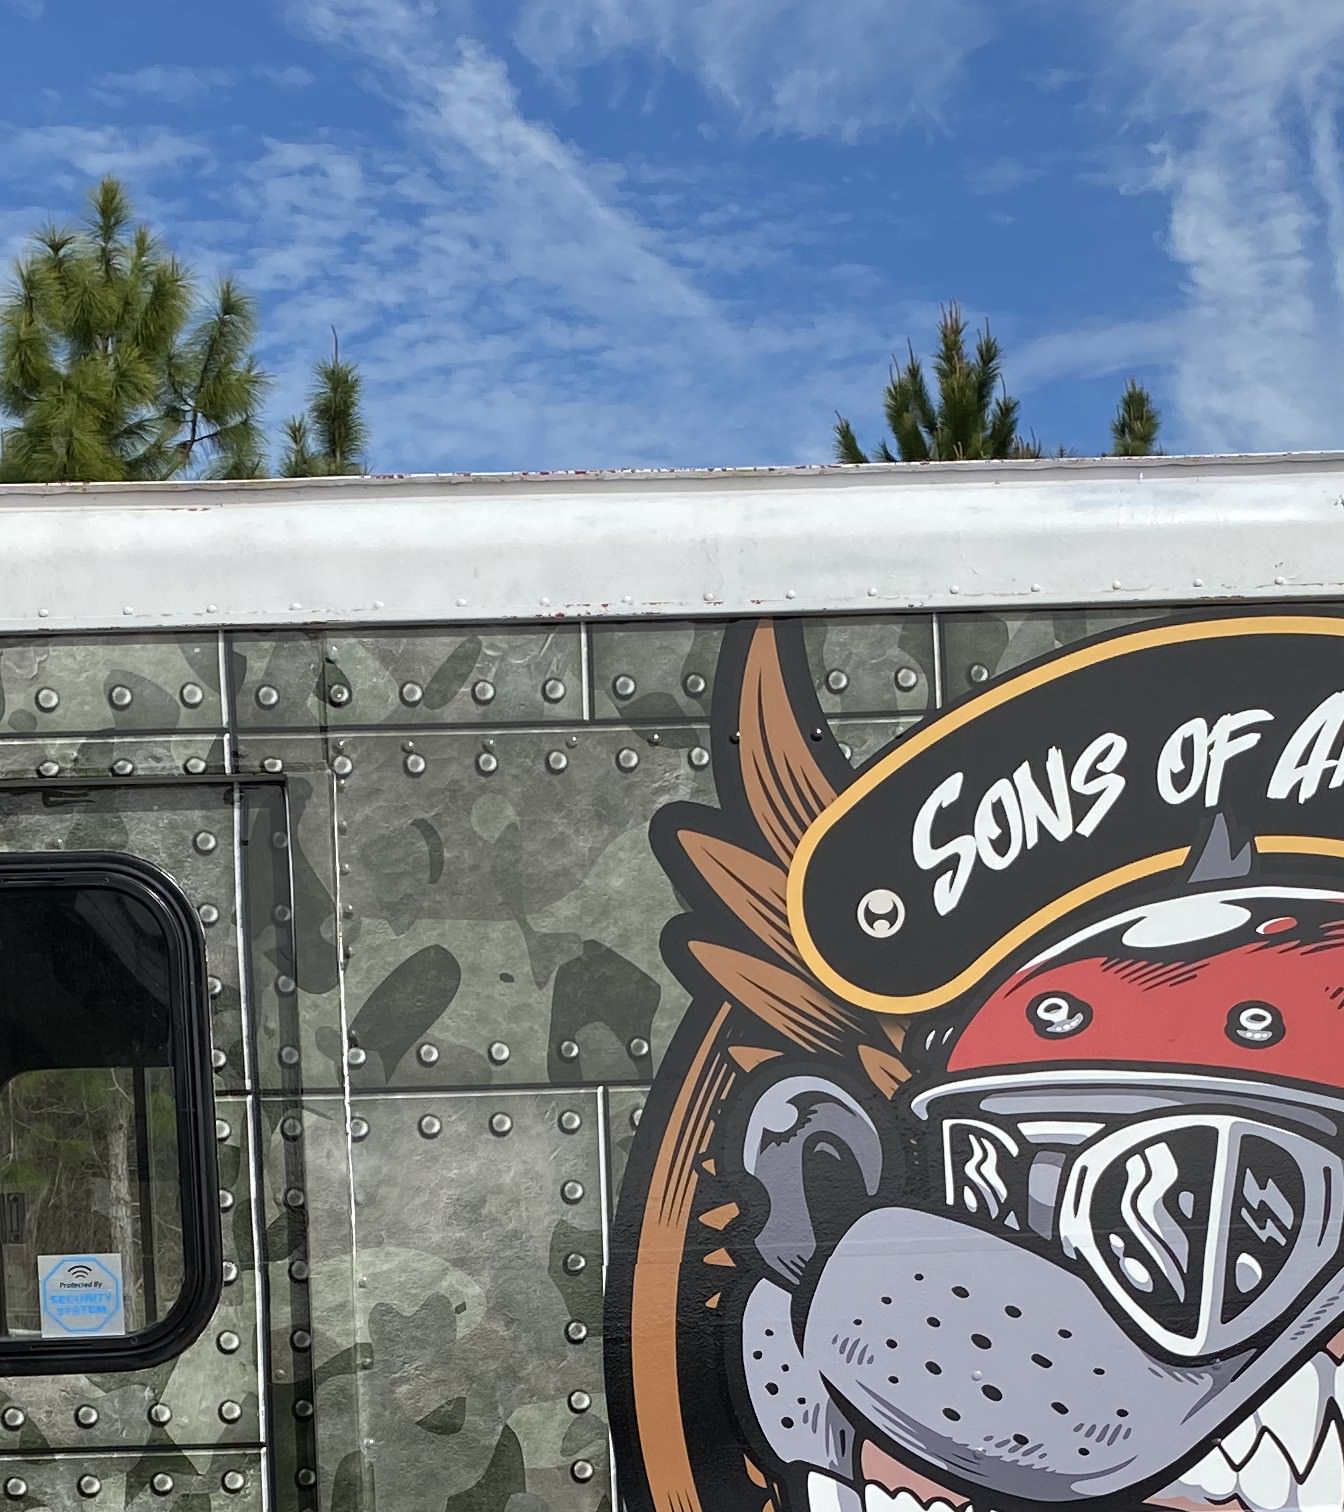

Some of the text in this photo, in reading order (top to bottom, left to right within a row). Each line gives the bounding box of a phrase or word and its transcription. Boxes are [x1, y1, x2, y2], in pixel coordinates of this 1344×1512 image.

[912, 732, 1128, 916] SONS
[1156, 708, 1276, 808] OF
[93, 1281, 103, 1289] By
[50, 1291, 112, 1304] SECURITY
